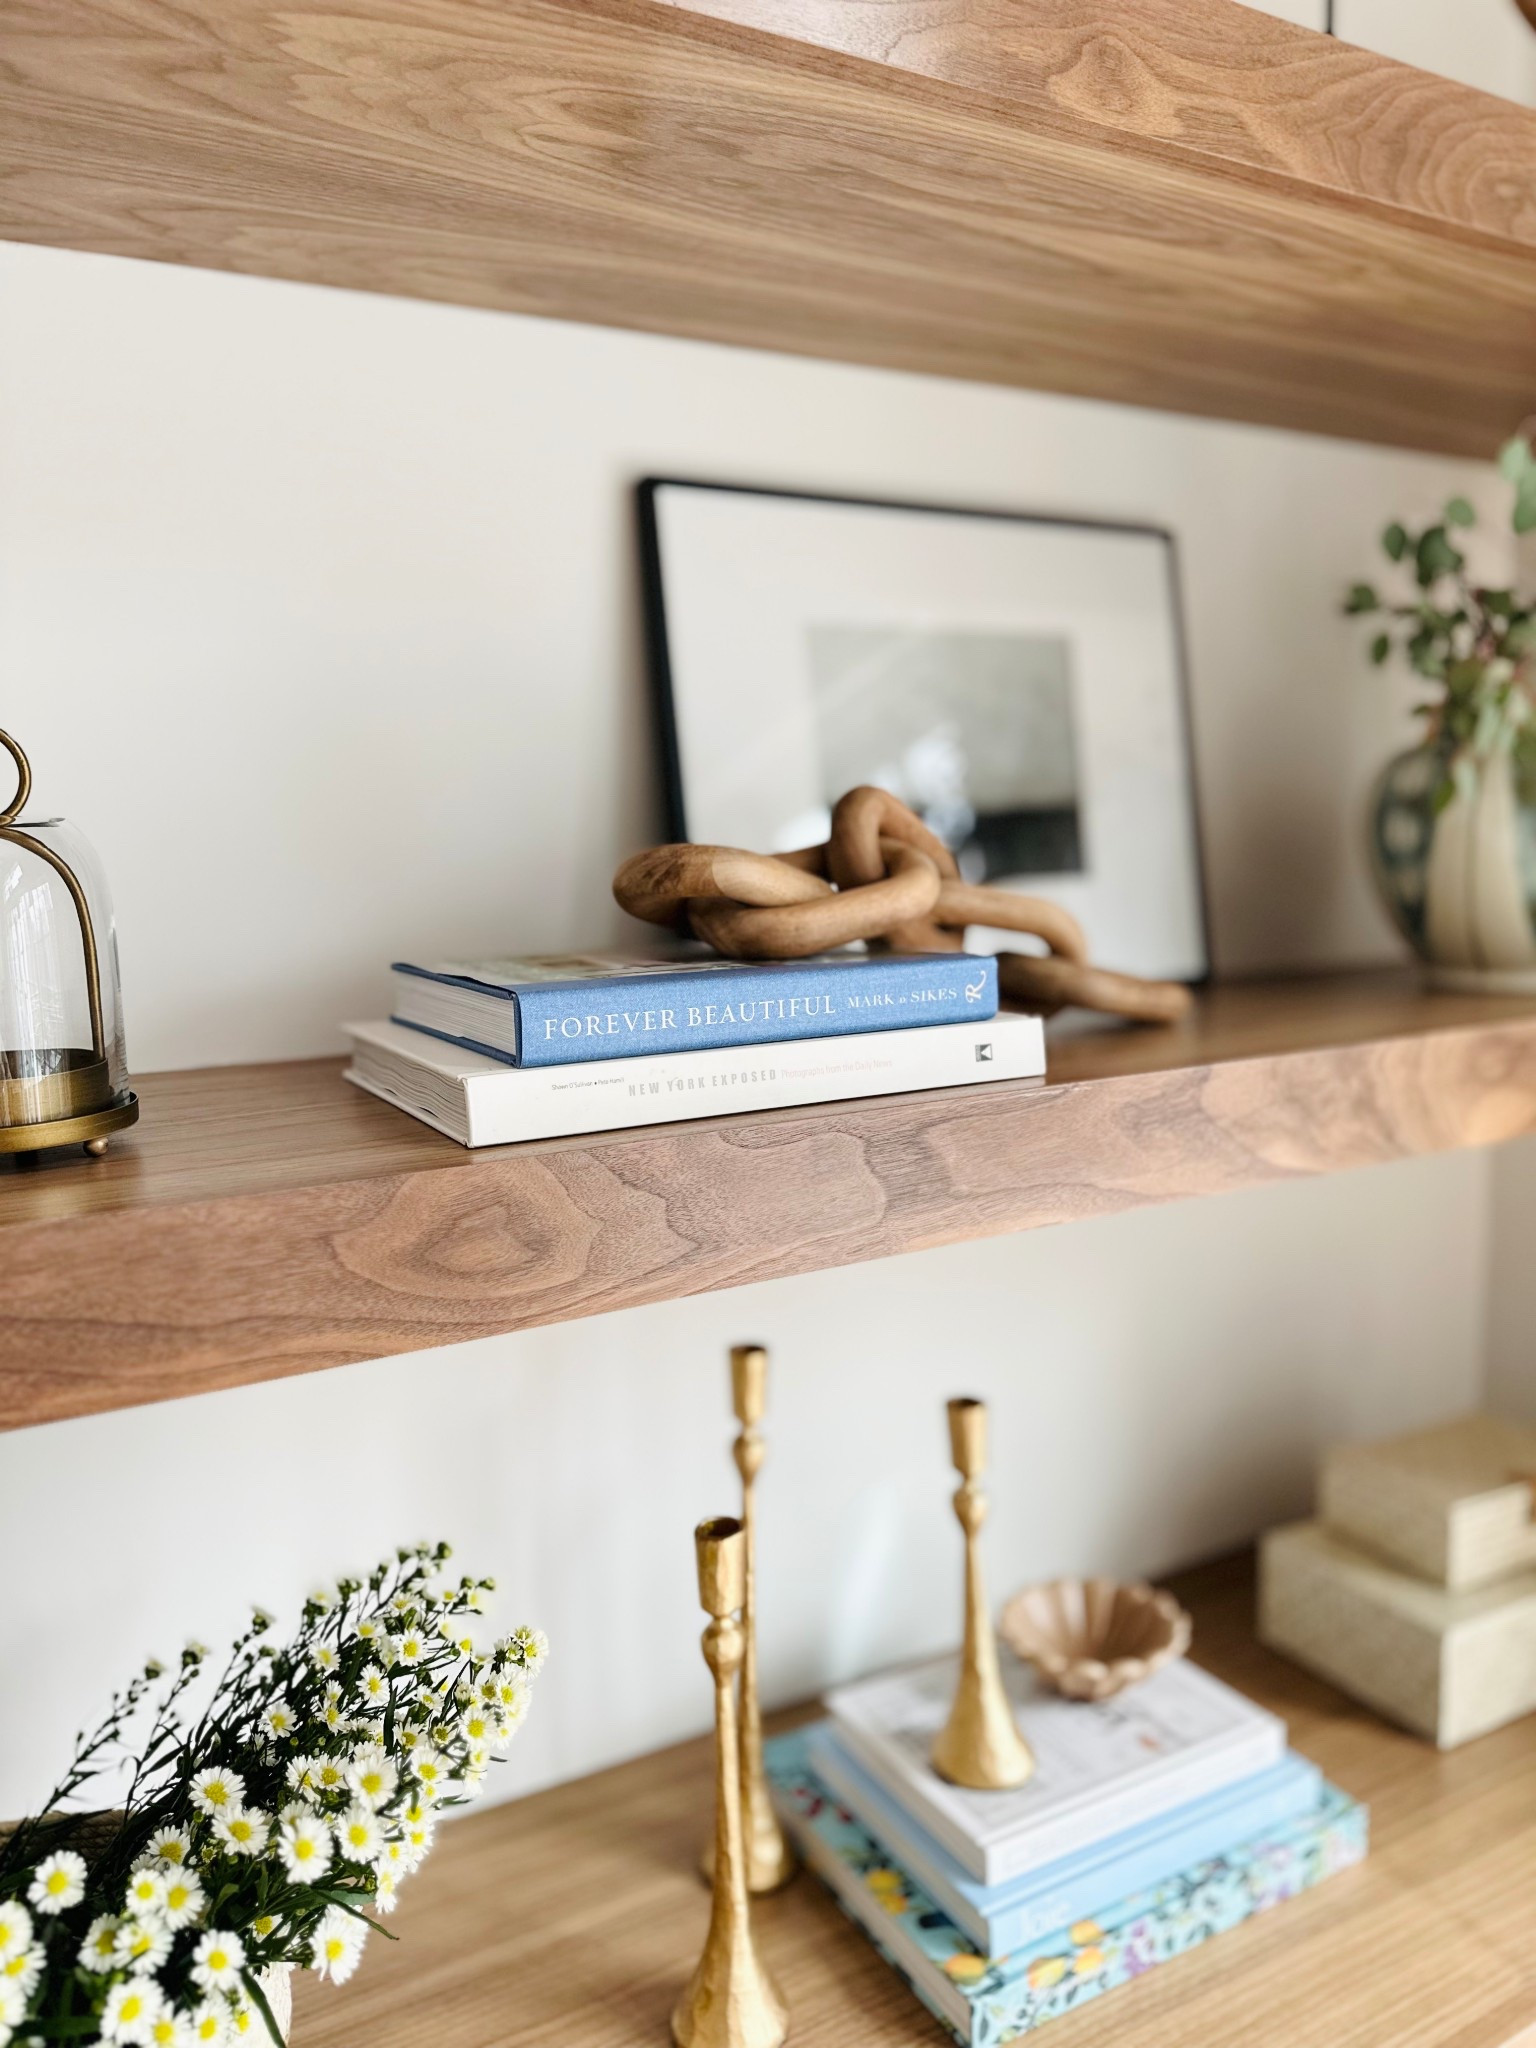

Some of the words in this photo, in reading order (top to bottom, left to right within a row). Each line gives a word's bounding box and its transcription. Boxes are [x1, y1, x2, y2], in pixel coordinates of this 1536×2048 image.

[544, 1009, 677, 1040] FOREVER
[687, 995, 836, 1027] BEAUTIFUL
[848, 994, 894, 1008] MARK
[910, 987, 958, 1003] SIKES
[628, 1082, 660, 1097] NEW
[667, 1077, 706, 1092] YORK
[712, 1069, 777, 1087] EXPOSED
[780, 1066, 825, 1080] Photographs
[825, 1064, 841, 1074] from
[842, 1062, 854, 1072] the
[854, 1060, 872, 1072] Daily
[873, 1058, 893, 1069] News
